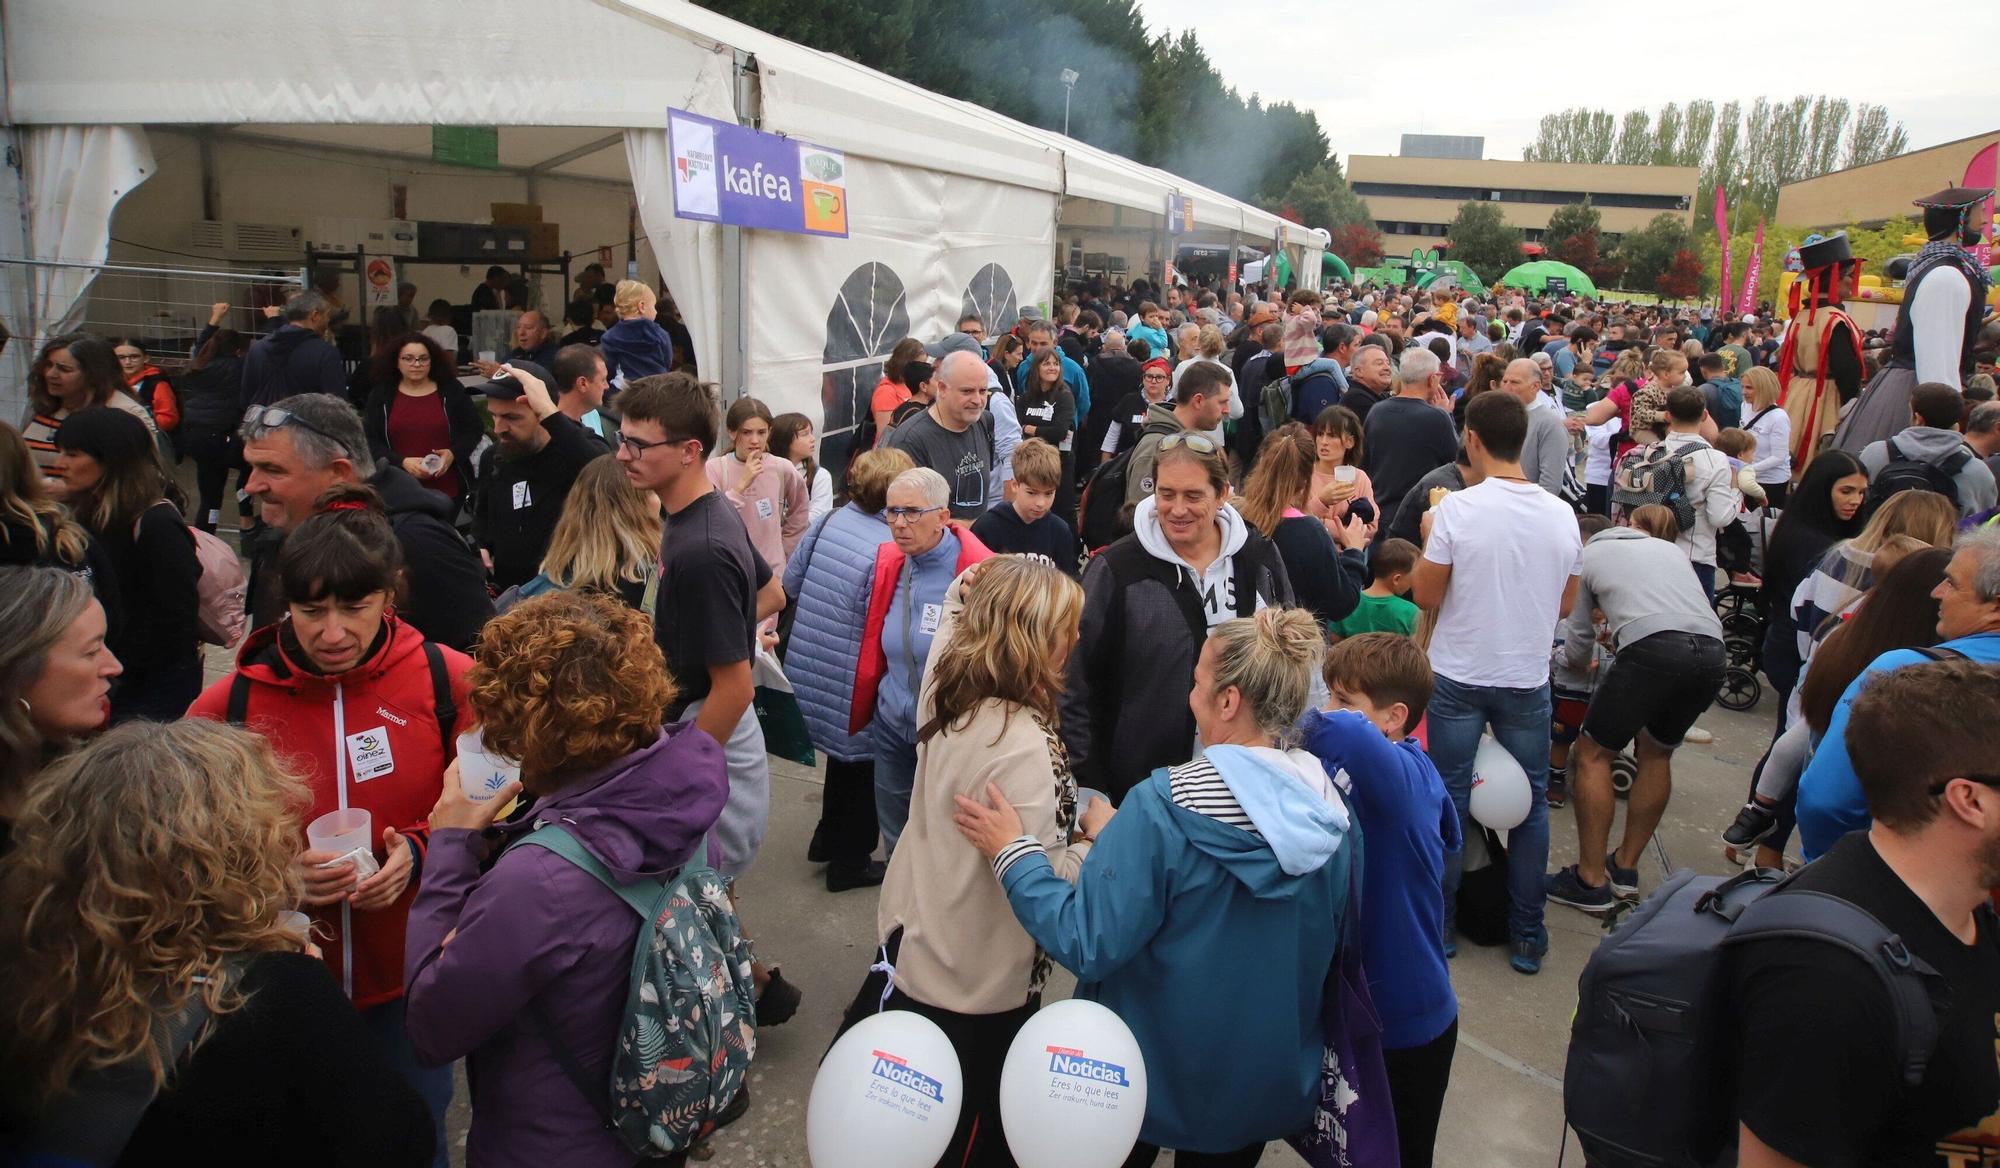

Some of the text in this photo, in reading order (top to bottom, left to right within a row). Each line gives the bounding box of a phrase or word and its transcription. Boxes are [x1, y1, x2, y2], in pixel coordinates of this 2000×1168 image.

[723, 155, 792, 202] kafea
[1744, 264, 1760, 307] LABORAL
[376, 706, 408, 727] Marmot
[875, 1059, 938, 1097] Noticias
[1052, 1054, 1121, 1084] Noticias
[870, 1079, 889, 1093] Eres
[891, 1087, 899, 1097] lo
[900, 1093, 916, 1105] que
[1048, 1090, 1061, 1099] Zer
[1050, 1077, 1120, 1100] Eres lo que lees
